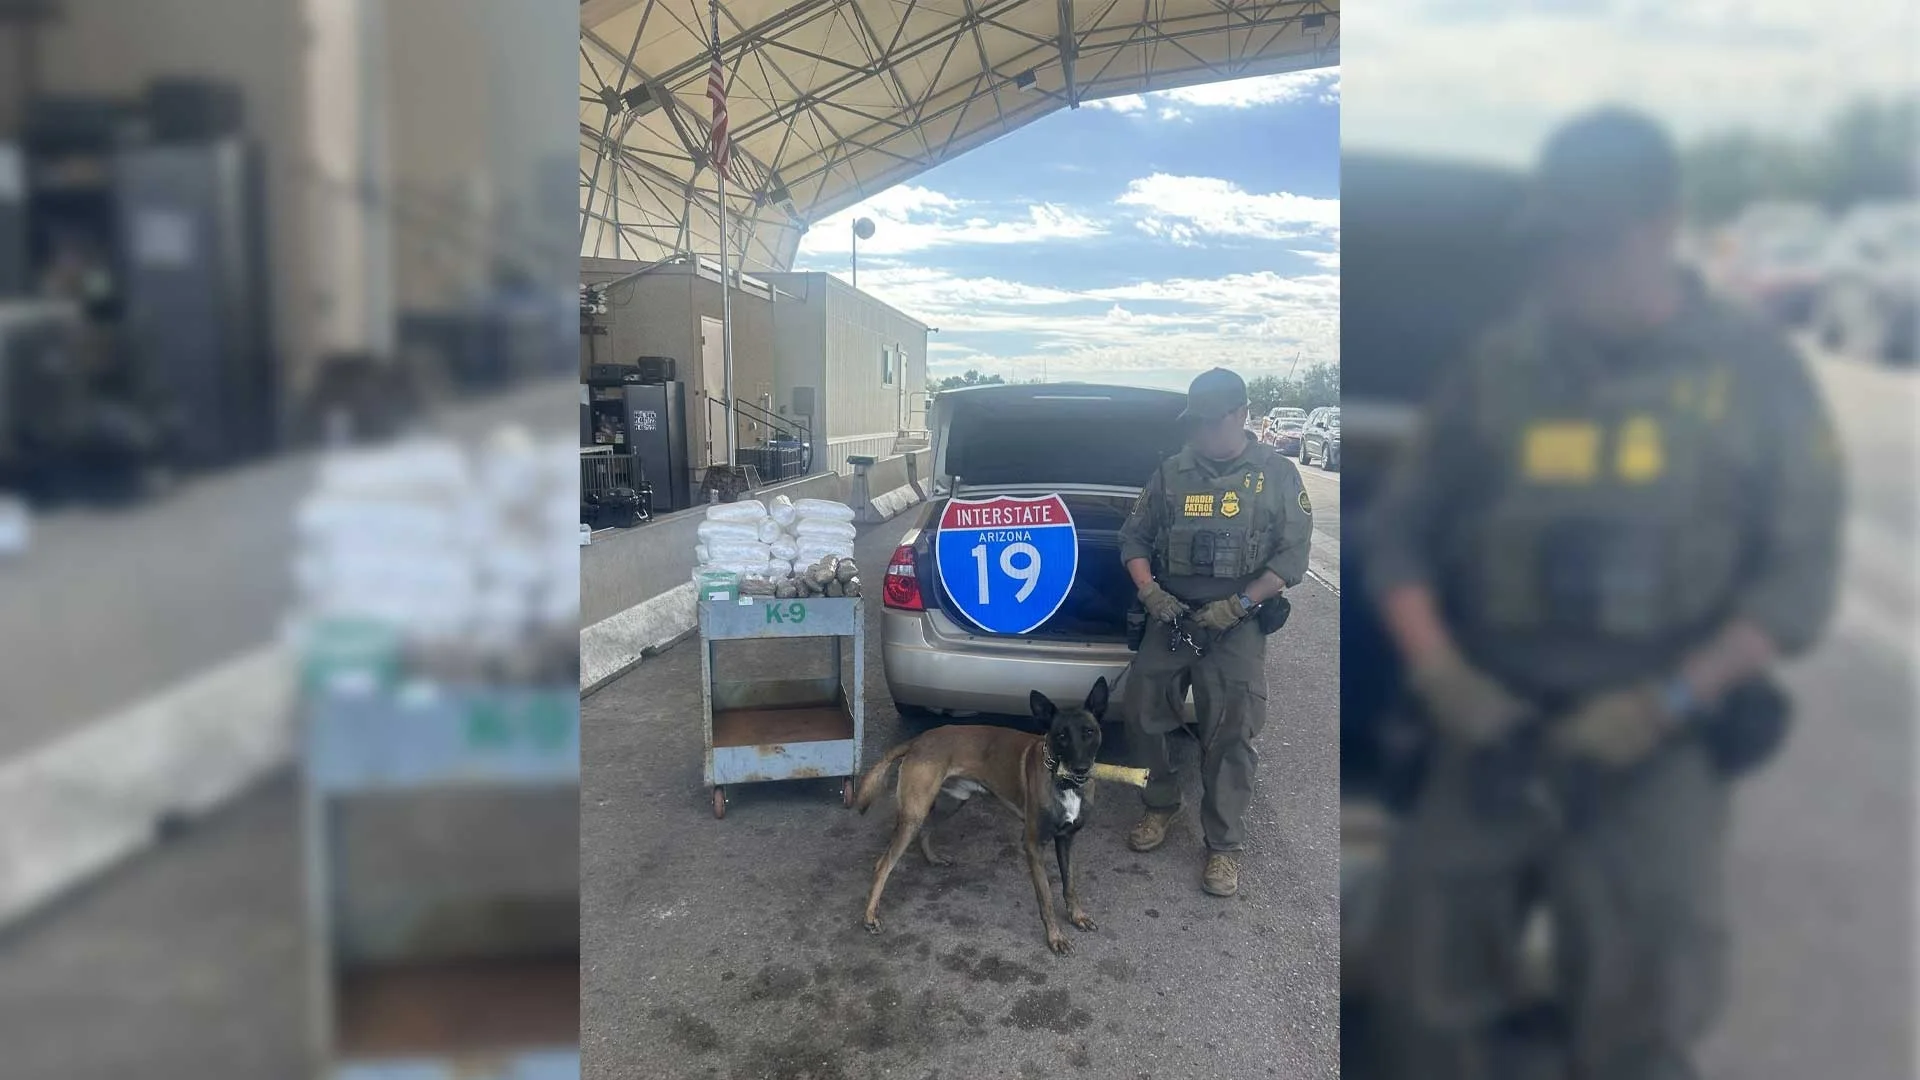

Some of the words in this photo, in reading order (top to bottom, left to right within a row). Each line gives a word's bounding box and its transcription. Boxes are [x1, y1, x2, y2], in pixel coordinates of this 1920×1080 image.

[1185, 495, 1214, 503] BORDER
[957, 505, 1052, 526] INTERSTATE
[1184, 503, 1213, 512] PATROL
[979, 531, 1032, 543] ARIZONA
[971, 542, 1041, 605] 19
[766, 602, 806, 624] K-9
